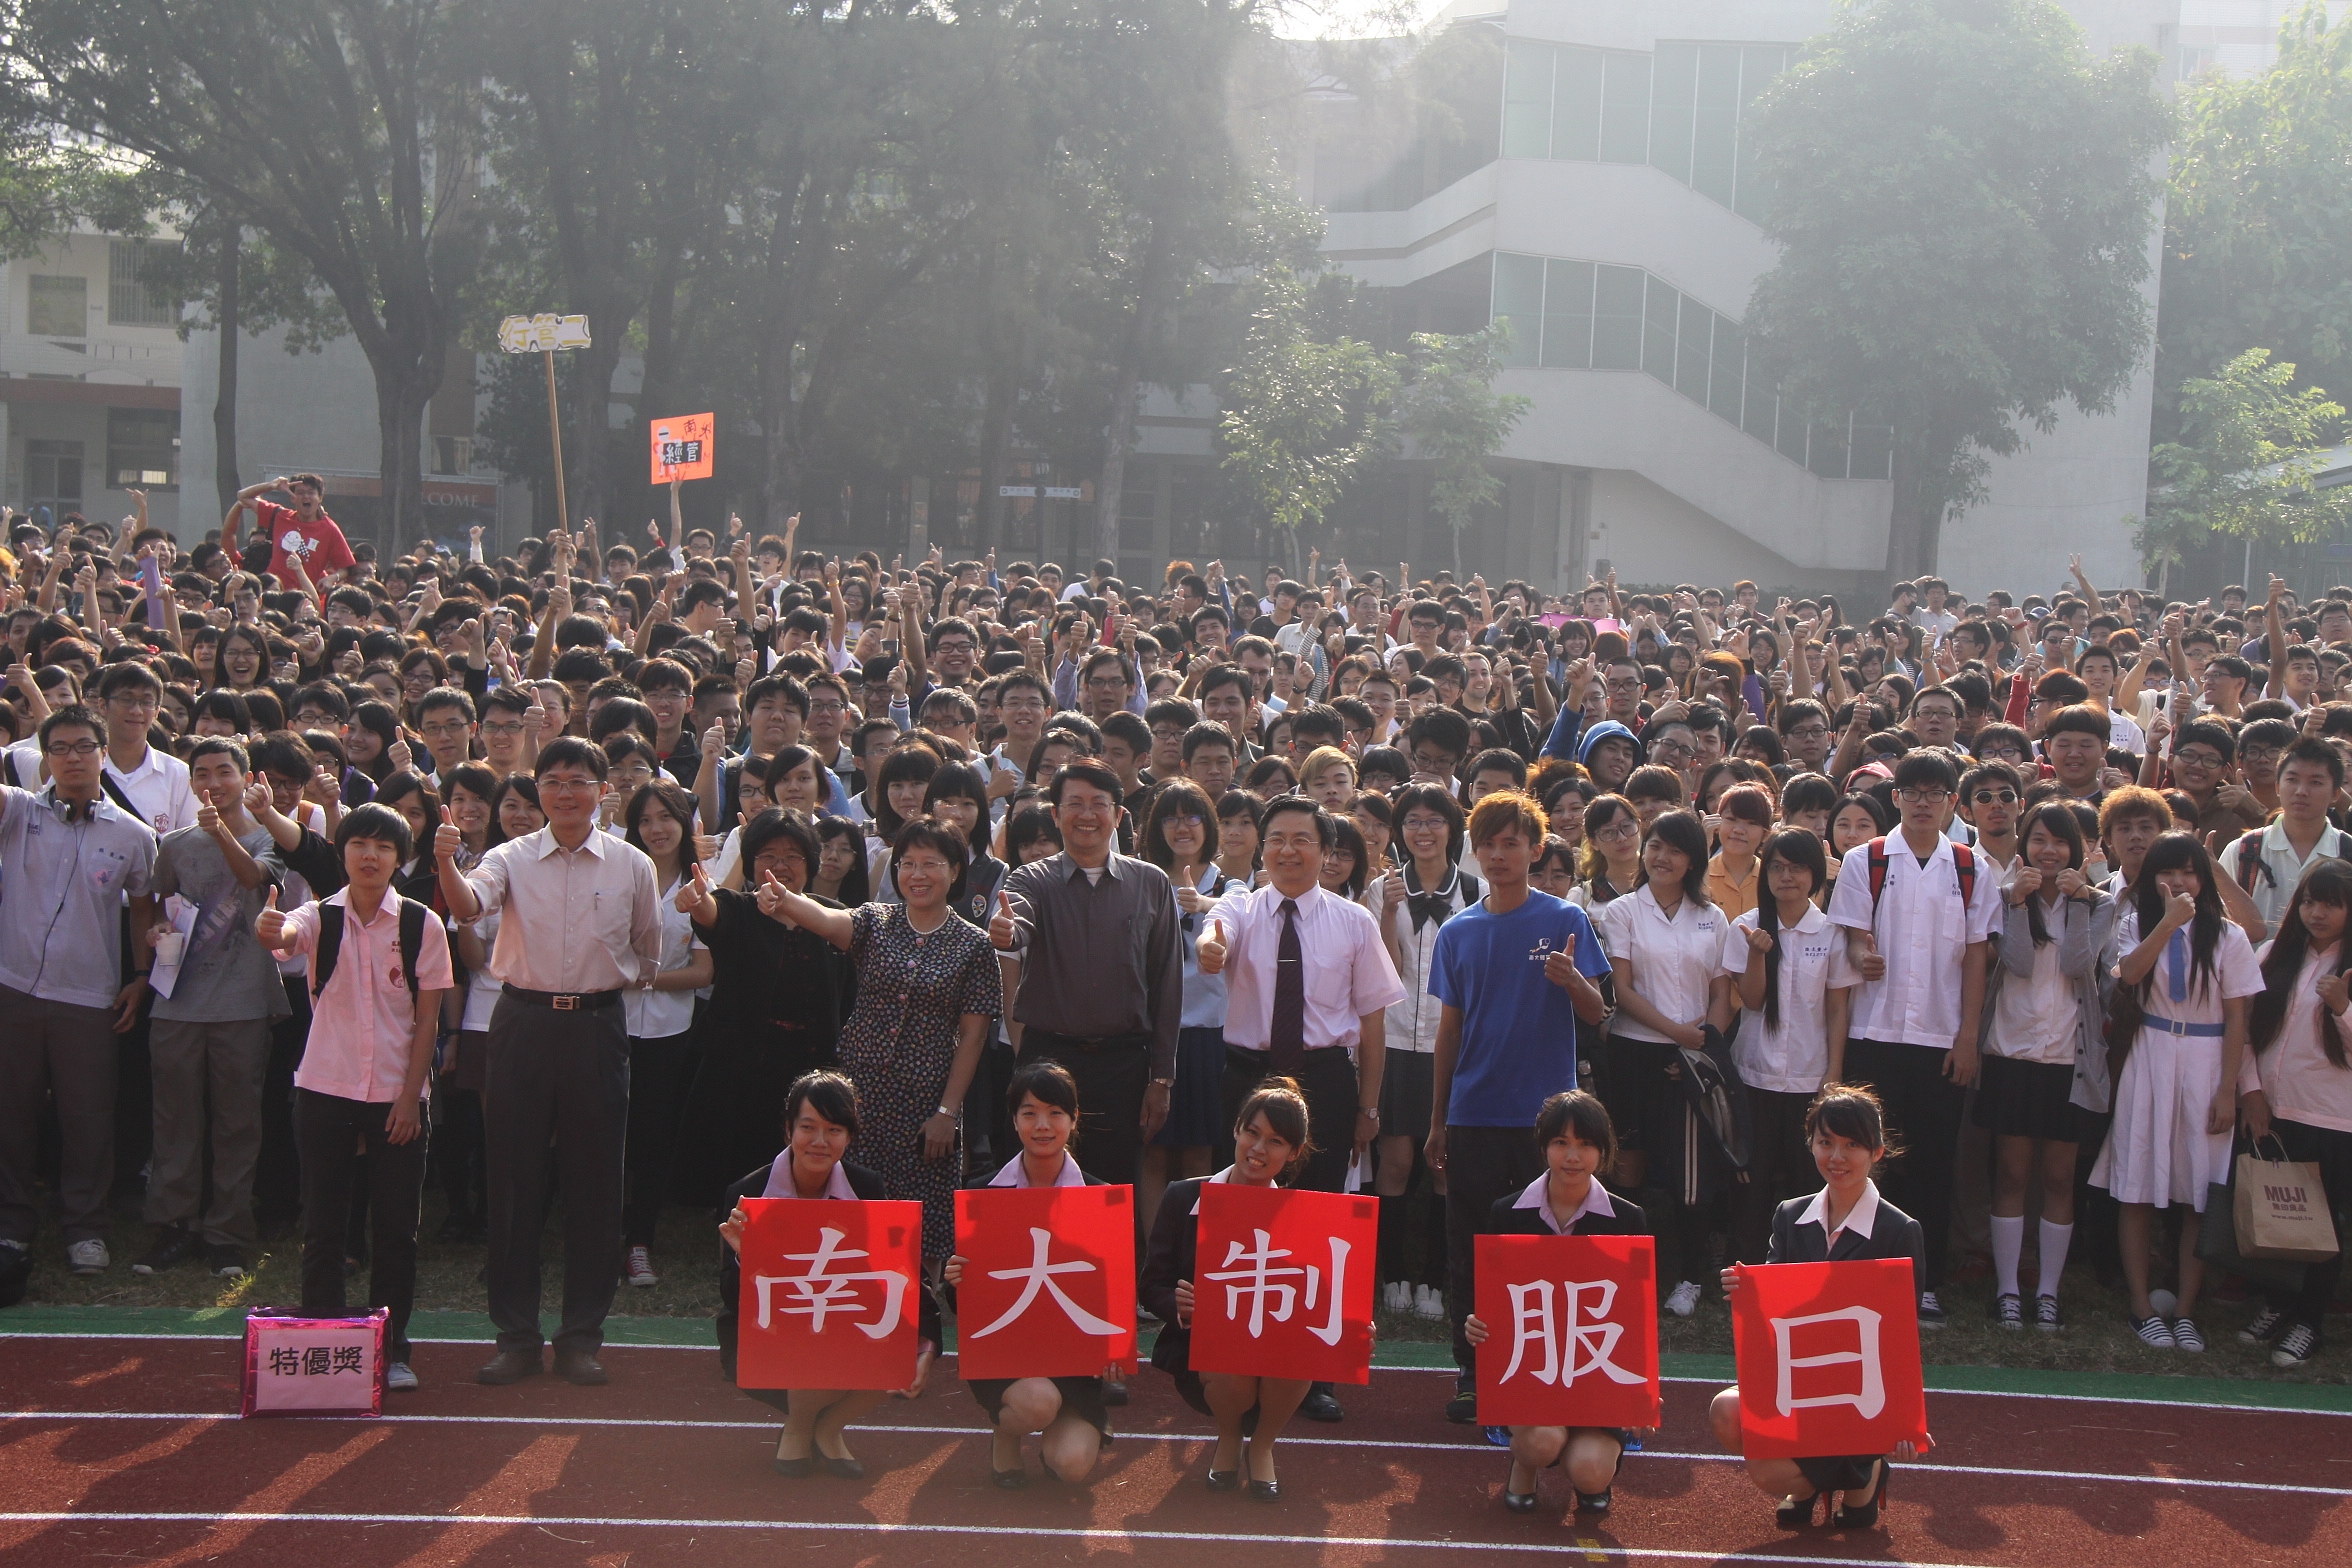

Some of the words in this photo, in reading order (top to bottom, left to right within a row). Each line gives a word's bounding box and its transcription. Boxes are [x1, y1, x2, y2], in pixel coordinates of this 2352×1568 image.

[665, 441, 699, 465] 經管
[420, 491, 479, 508] LCOME
[2263, 1185, 2308, 1203] MUJI
[2271, 1202, 2307, 1212] 無印良品
[2271, 1213, 2314, 1222] www.muji.tw
[755, 1226, 910, 1340] 南
[970, 1226, 1127, 1339] 大
[1203, 1228, 1351, 1347] 制
[1498, 1279, 1648, 1389] 服
[269, 1346, 363, 1376] 特優獎
[1769, 1305, 1886, 1420] 日
